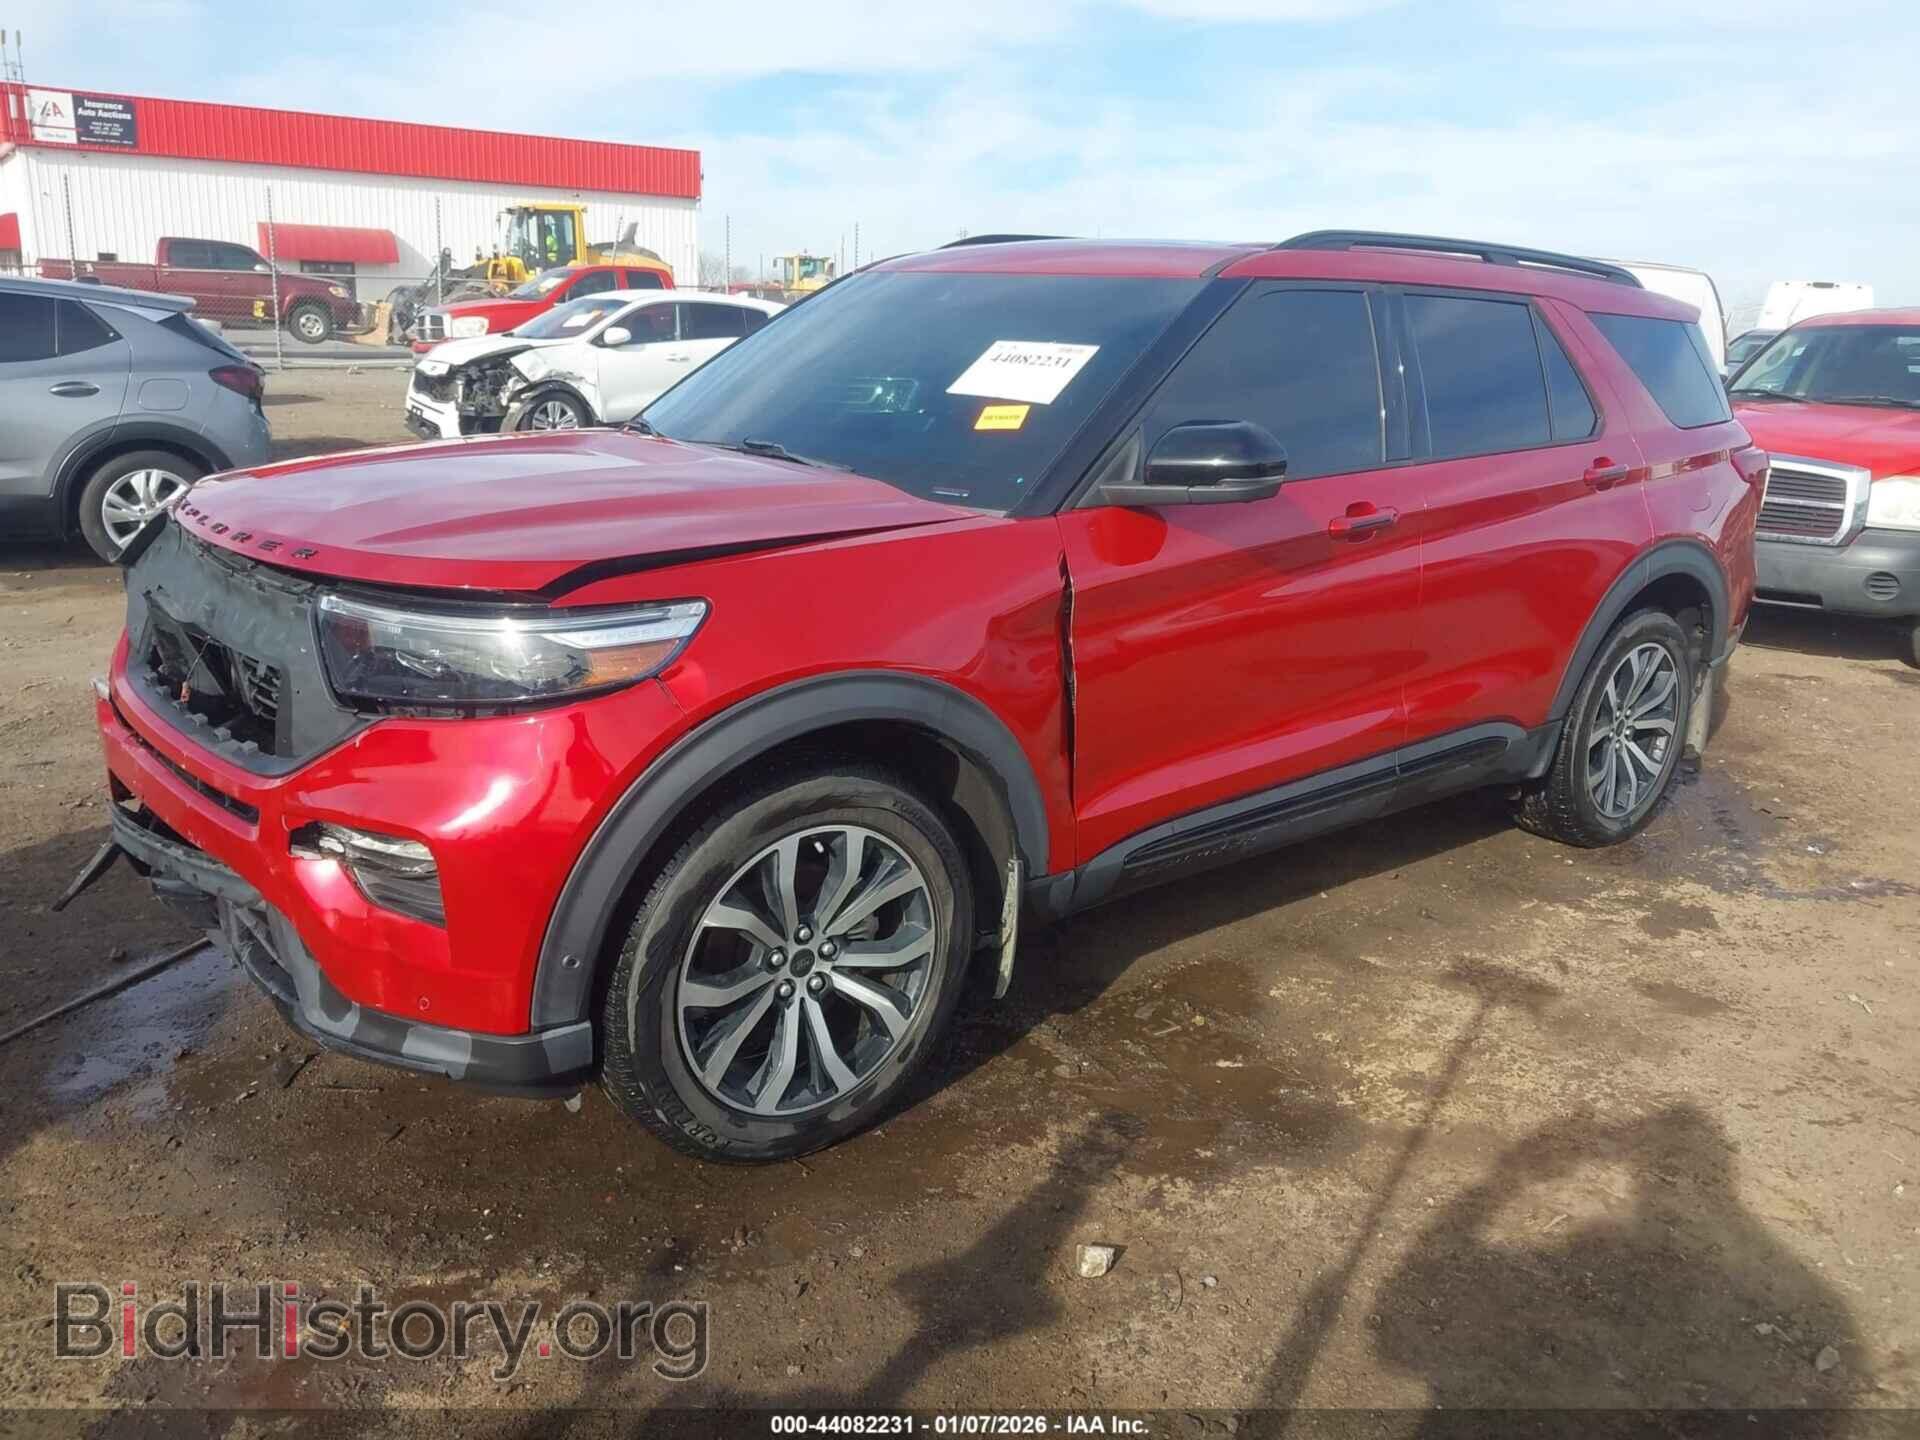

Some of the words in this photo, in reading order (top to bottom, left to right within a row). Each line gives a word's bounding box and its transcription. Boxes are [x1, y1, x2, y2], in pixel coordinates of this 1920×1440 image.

[84, 99, 123, 110] Insurance
[78, 107, 96, 117] Auto
[97, 109, 132, 120] Auctions
